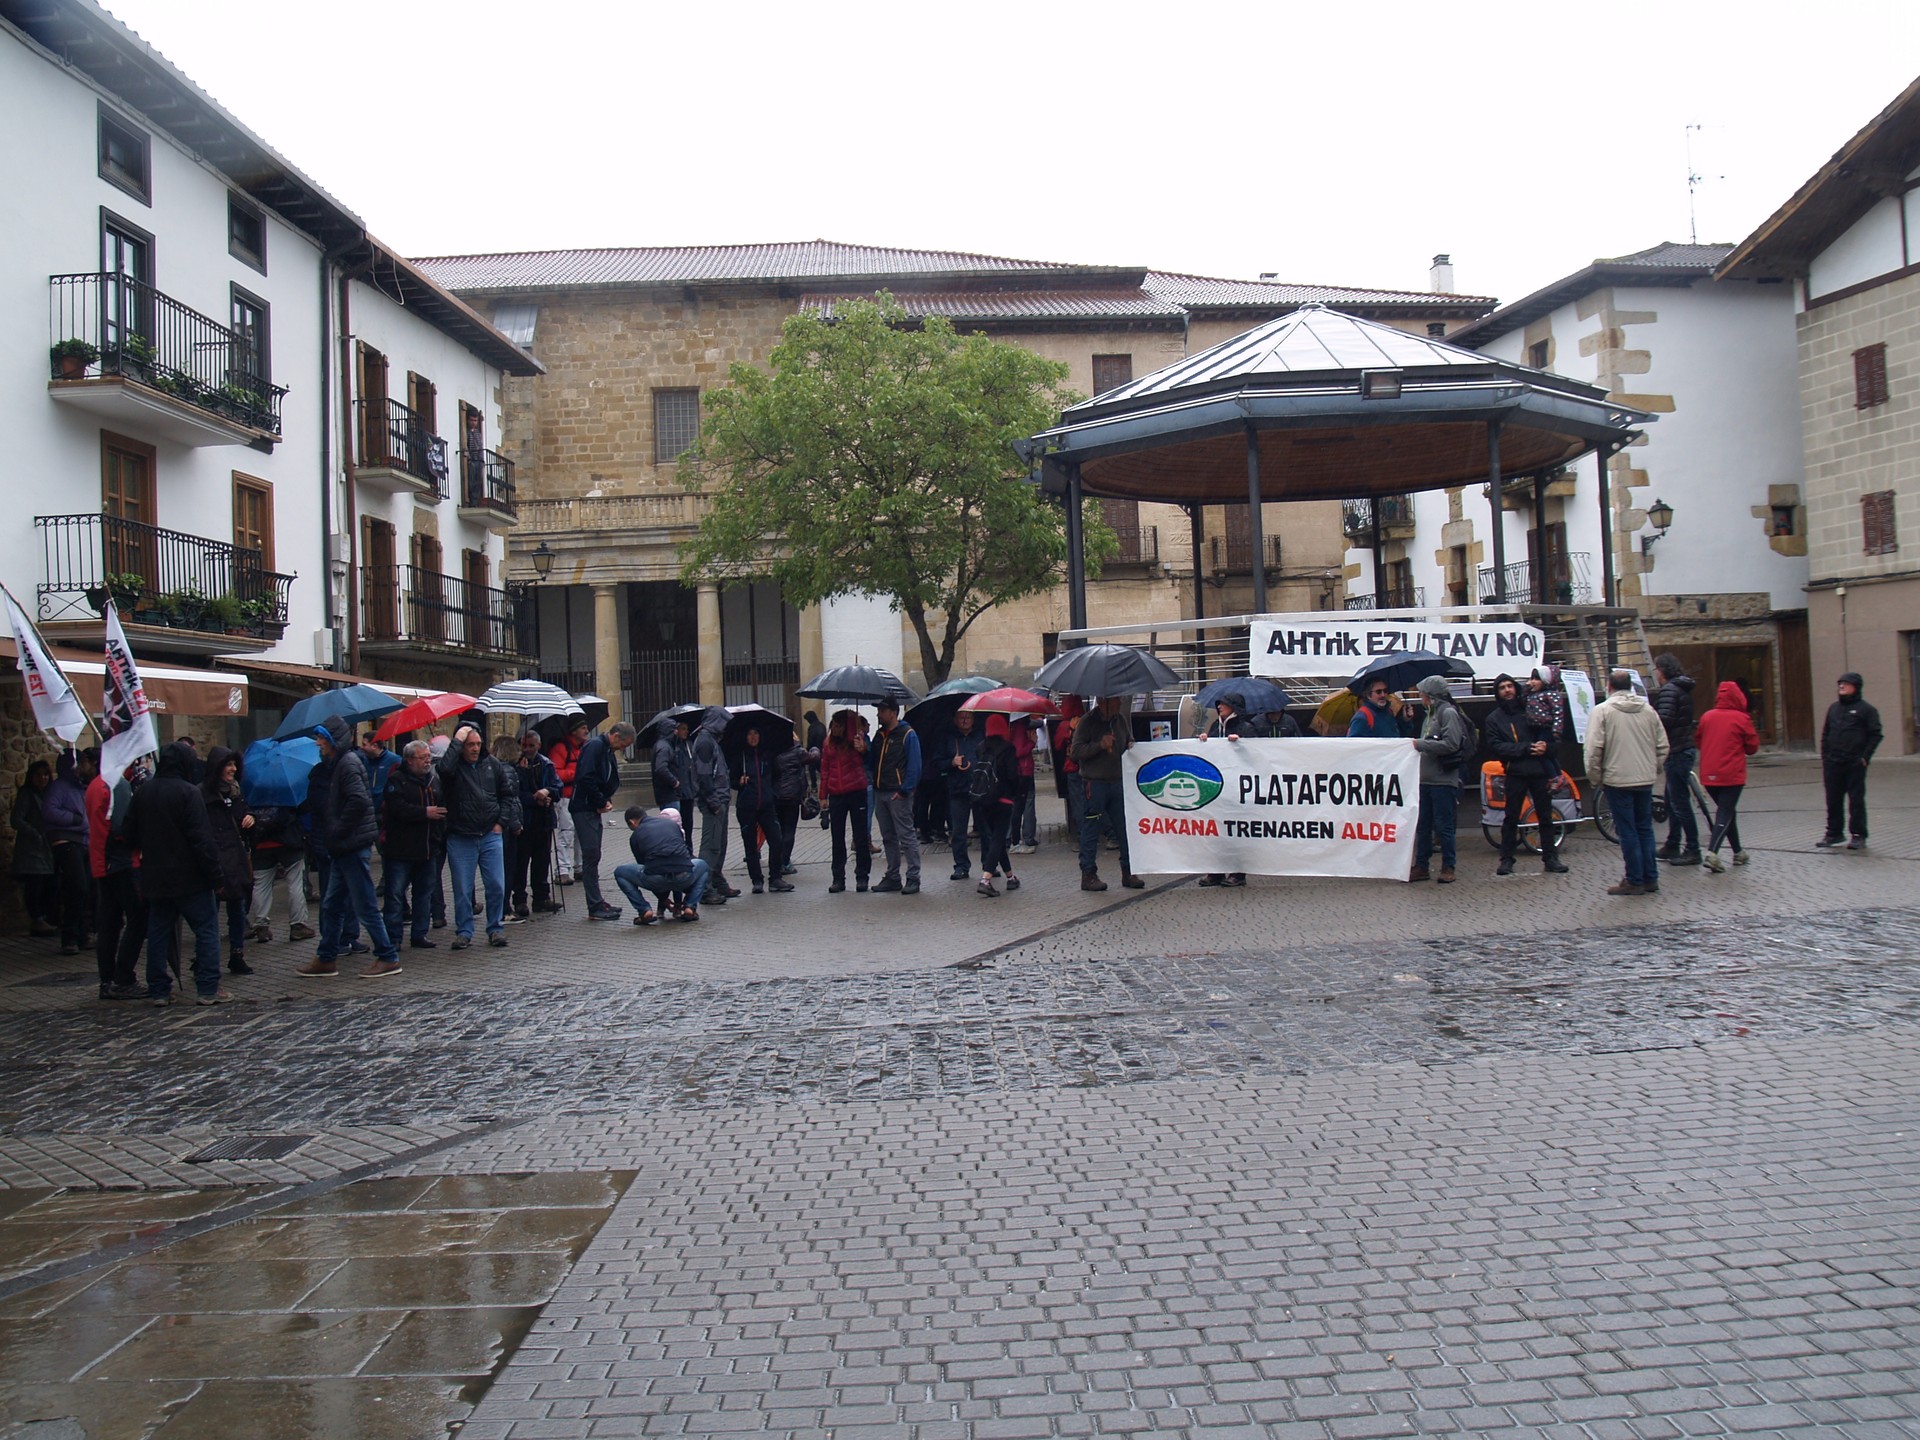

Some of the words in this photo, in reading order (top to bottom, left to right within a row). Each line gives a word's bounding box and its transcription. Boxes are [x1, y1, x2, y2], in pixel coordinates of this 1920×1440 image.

[1267, 630, 1361, 656] AHTrik
[1367, 632, 1408, 655] EZ!
[1431, 633, 1489, 657] TAV
[1496, 632, 1538, 658] NO!
[106, 639, 138, 689] AHTrik
[132, 688, 150, 717] EZ!
[1239, 773, 1403, 807] PLATAFORMA
[1138, 817, 1219, 837] SAKANA
[1224, 820, 1334, 839] TRENAREN
[1341, 822, 1397, 843] ALDE
